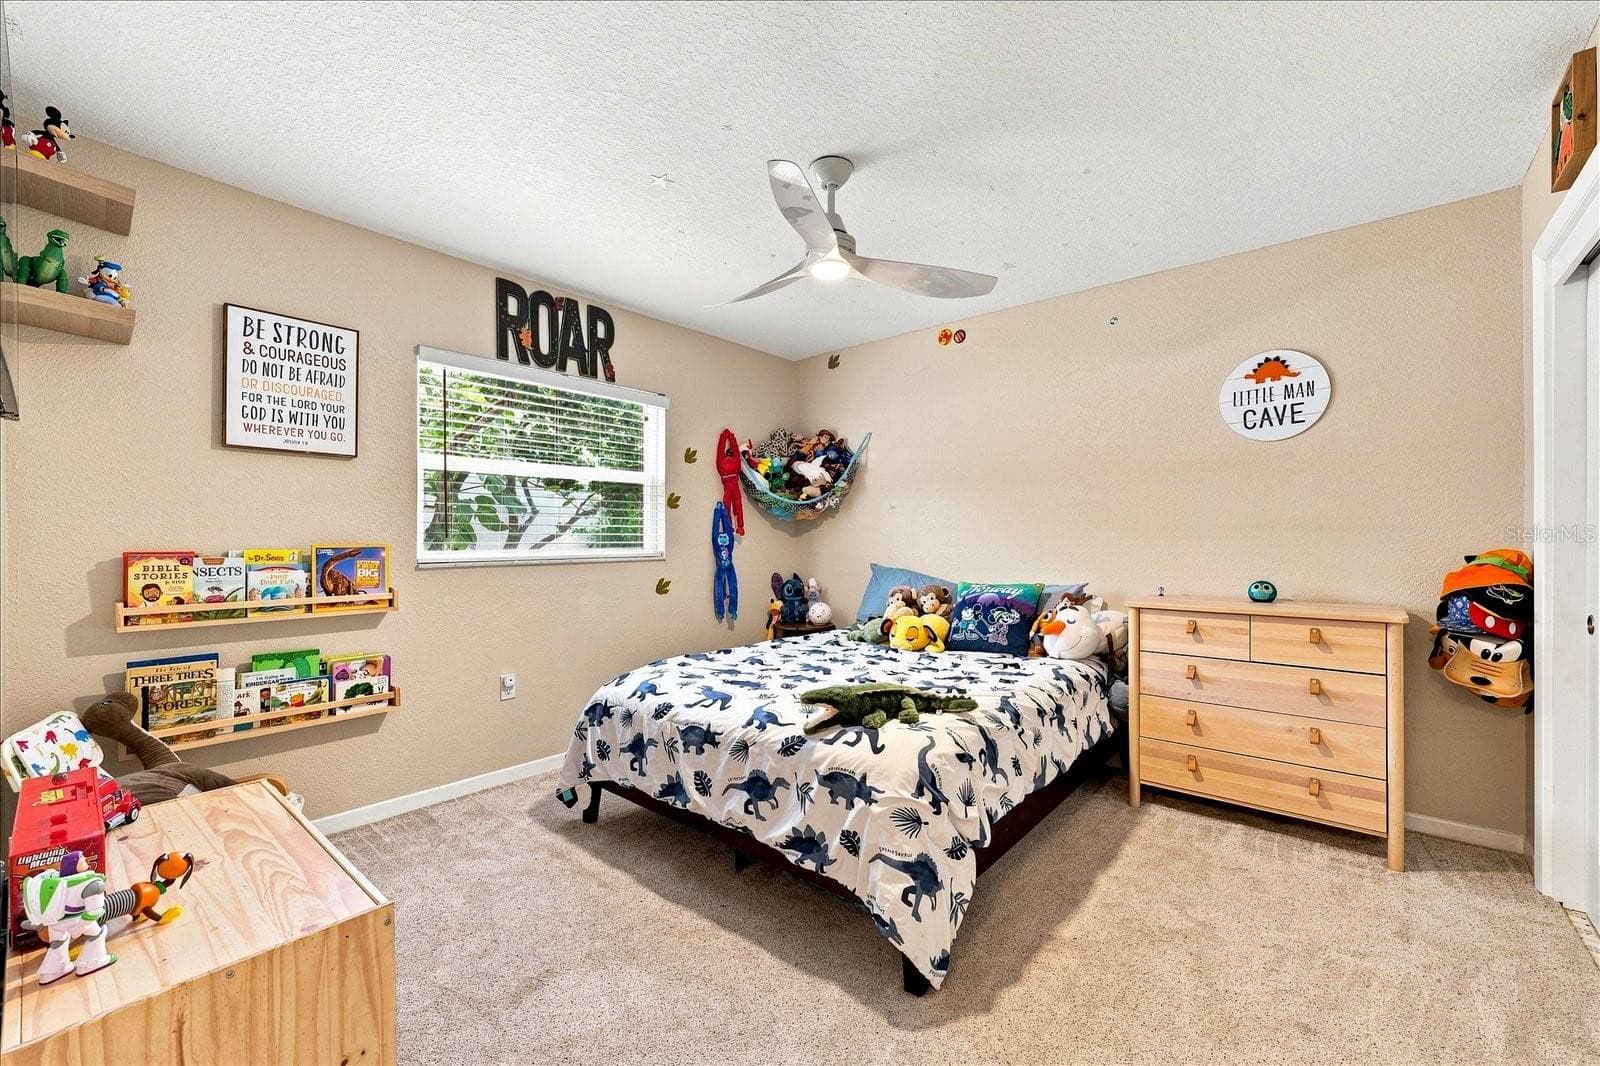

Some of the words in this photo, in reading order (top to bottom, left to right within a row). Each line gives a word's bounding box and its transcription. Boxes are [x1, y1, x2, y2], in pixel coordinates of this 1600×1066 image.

[242, 316, 266, 340] BE
[273, 322, 346, 355] STRONG
[496, 277, 616, 382] ROAR
[243, 341, 255, 355] &
[259, 344, 347, 371] COURAGEOUS
[242, 358, 257, 375] DO
[262, 361, 284, 379] NOT
[288, 366, 302, 382] BE
[305, 369, 346, 388] AFRAID
[241, 377, 257, 389] OR
[262, 380, 345, 402] DISCOURAGED.
[1233, 386, 1275, 407] LITTLE
[1284, 380, 1315, 400] MAN
[241, 392, 263, 403] FOR
[266, 395, 287, 406] THE
[291, 399, 317, 411] LORD
[320, 402, 345, 414] YOUR
[241, 405, 266, 421] GOD
[271, 408, 284, 423] IS
[288, 411, 319, 427] WITH
[323, 415, 346, 430] YOU
[1243, 402, 1306, 430] CAVE
[243, 422, 304, 438] WHEREVER
[307, 430, 327, 440] YOU
[330, 432, 346, 443] GO.
[133, 572, 188, 581] STORIES
[142, 565, 180, 573] BIBLE
[192, 566, 243, 578] NSECTS
[357, 569, 379, 577] BIG
[130, 673, 173, 688] THREE
[176, 668, 214, 680] TREES
[154, 697, 212, 713] FOREST
